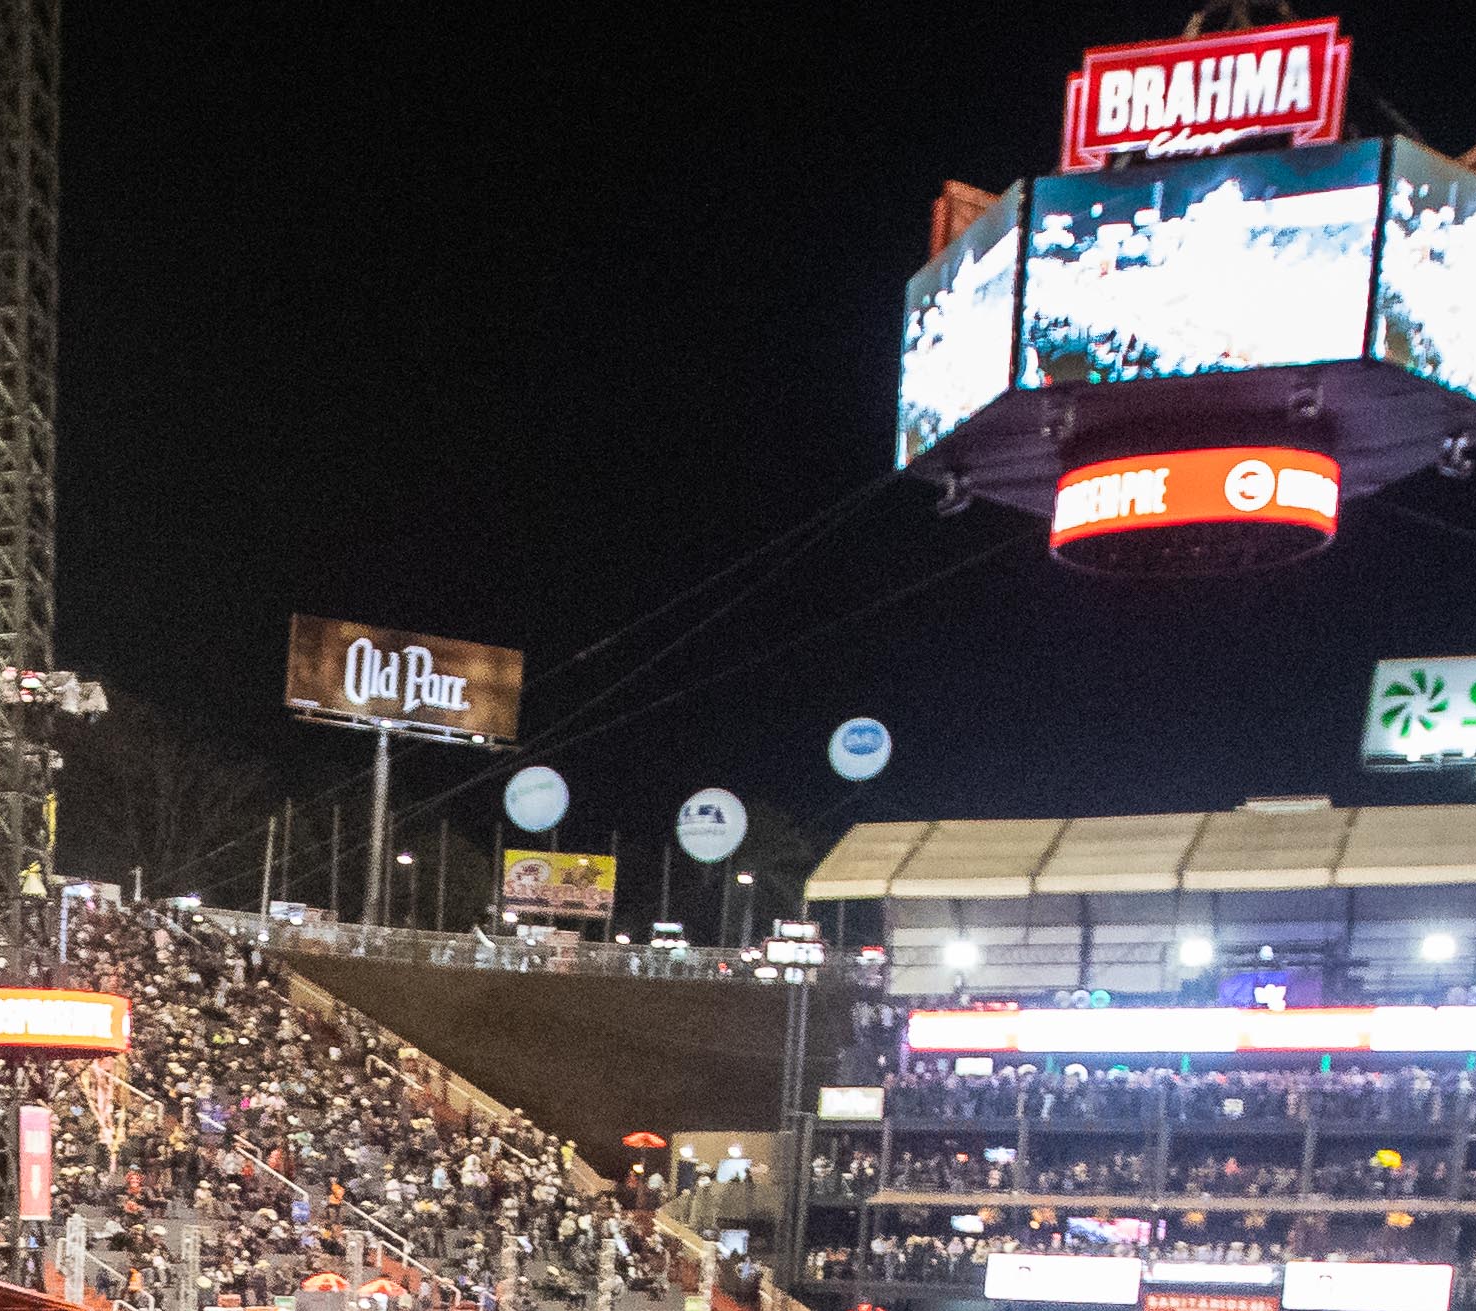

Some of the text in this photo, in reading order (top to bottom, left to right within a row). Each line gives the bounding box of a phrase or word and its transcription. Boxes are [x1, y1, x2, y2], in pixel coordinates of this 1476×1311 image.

[1096, 44, 1313, 137] BRAHMA
[344, 637, 471, 714] Old Parr
